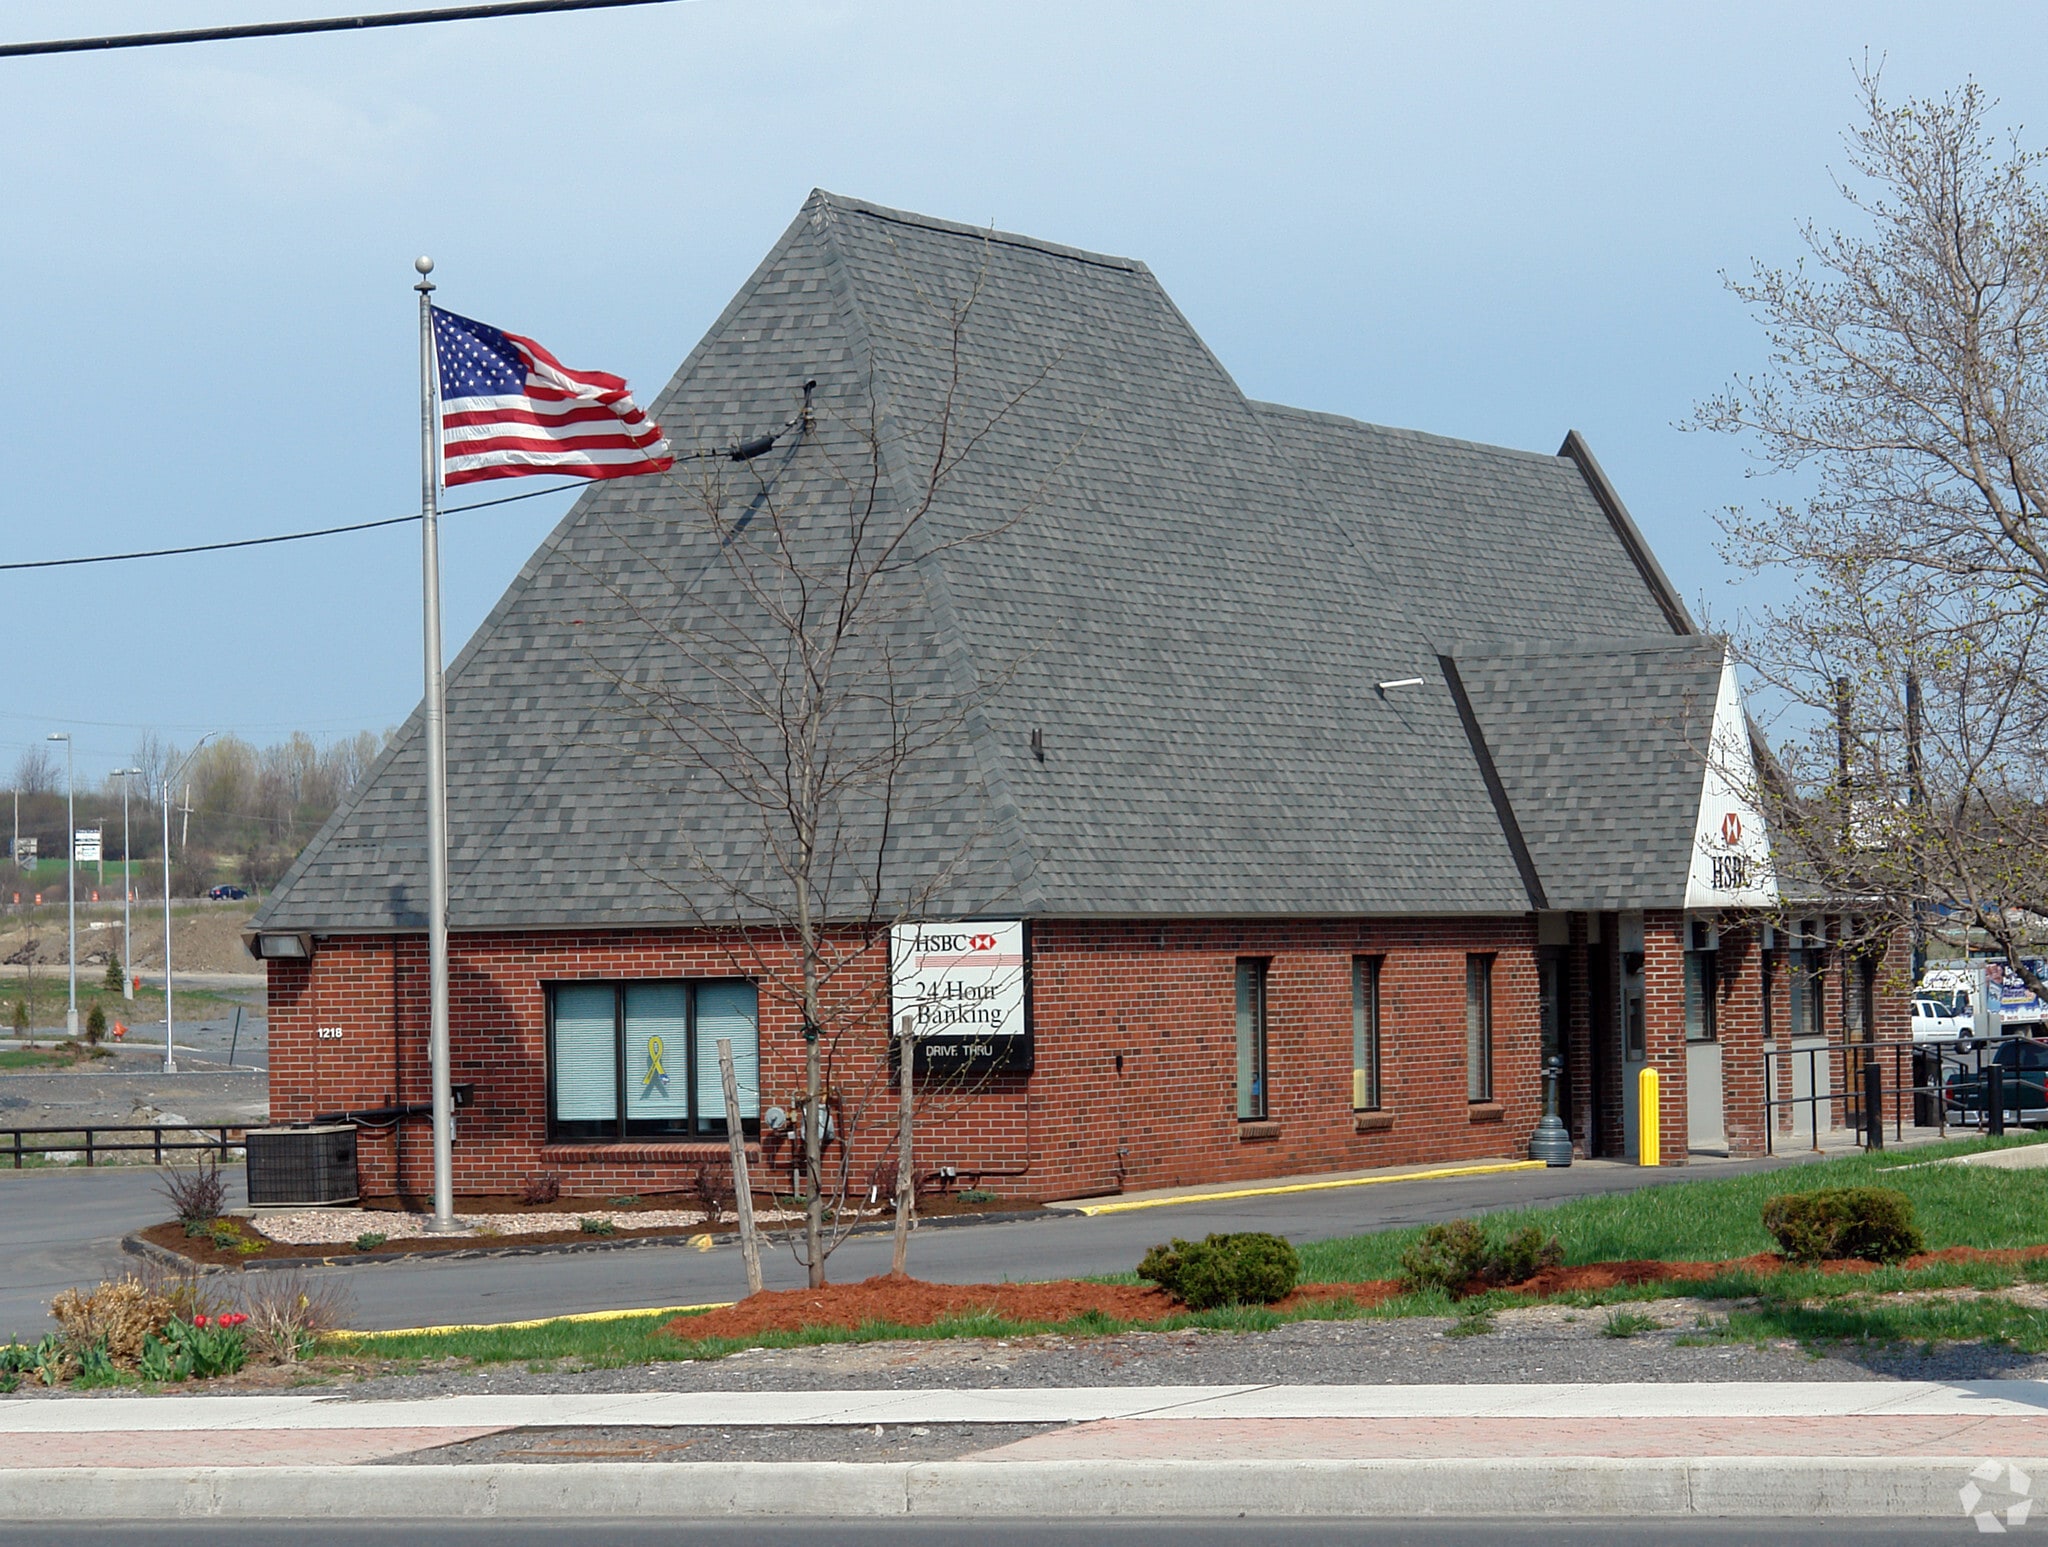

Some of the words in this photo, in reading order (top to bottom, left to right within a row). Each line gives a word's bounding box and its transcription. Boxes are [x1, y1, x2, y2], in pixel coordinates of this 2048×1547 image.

[1712, 856, 1753, 889] HSBC
[915, 934, 968, 952] HSBC
[916, 981, 938, 1001] 24
[947, 981, 996, 1001] Hour
[918, 1004, 1002, 1028] Banking
[318, 1027, 343, 1038] 1218
[925, 1045, 957, 1056] DRIVE
[963, 1045, 993, 1056] THRU
